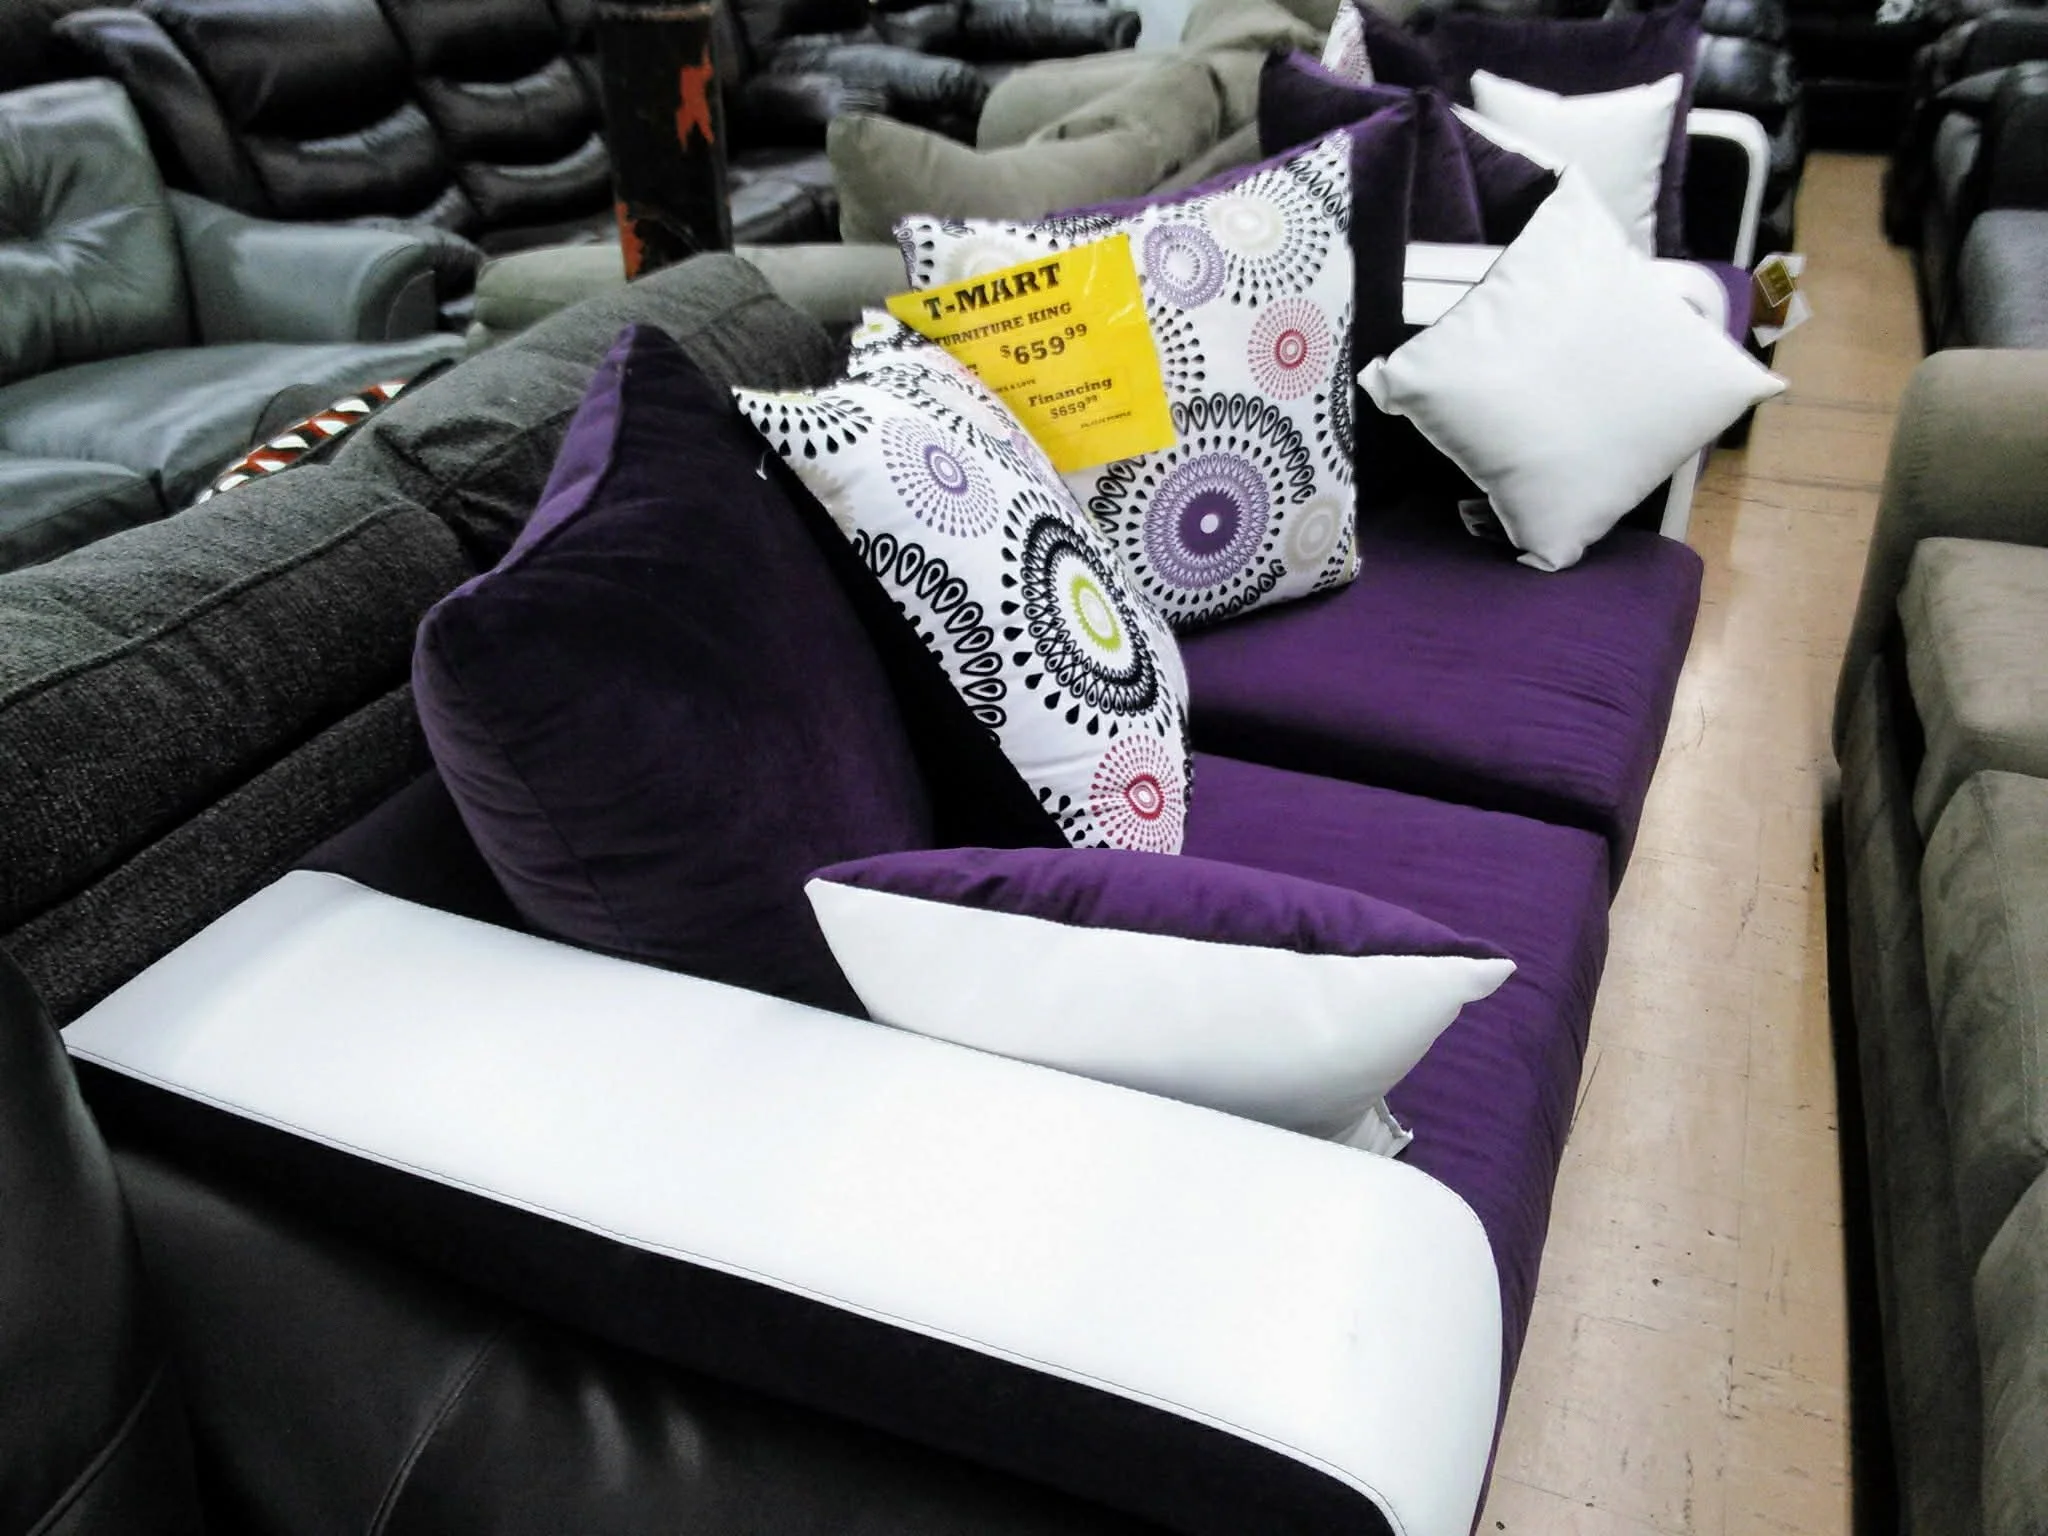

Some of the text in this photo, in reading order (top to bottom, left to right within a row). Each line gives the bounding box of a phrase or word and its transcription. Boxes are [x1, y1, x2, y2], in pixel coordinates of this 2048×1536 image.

[924, 262, 1061, 320] T-MART
[1029, 301, 1072, 325] KING
[1028, 377, 1112, 408] Financing
